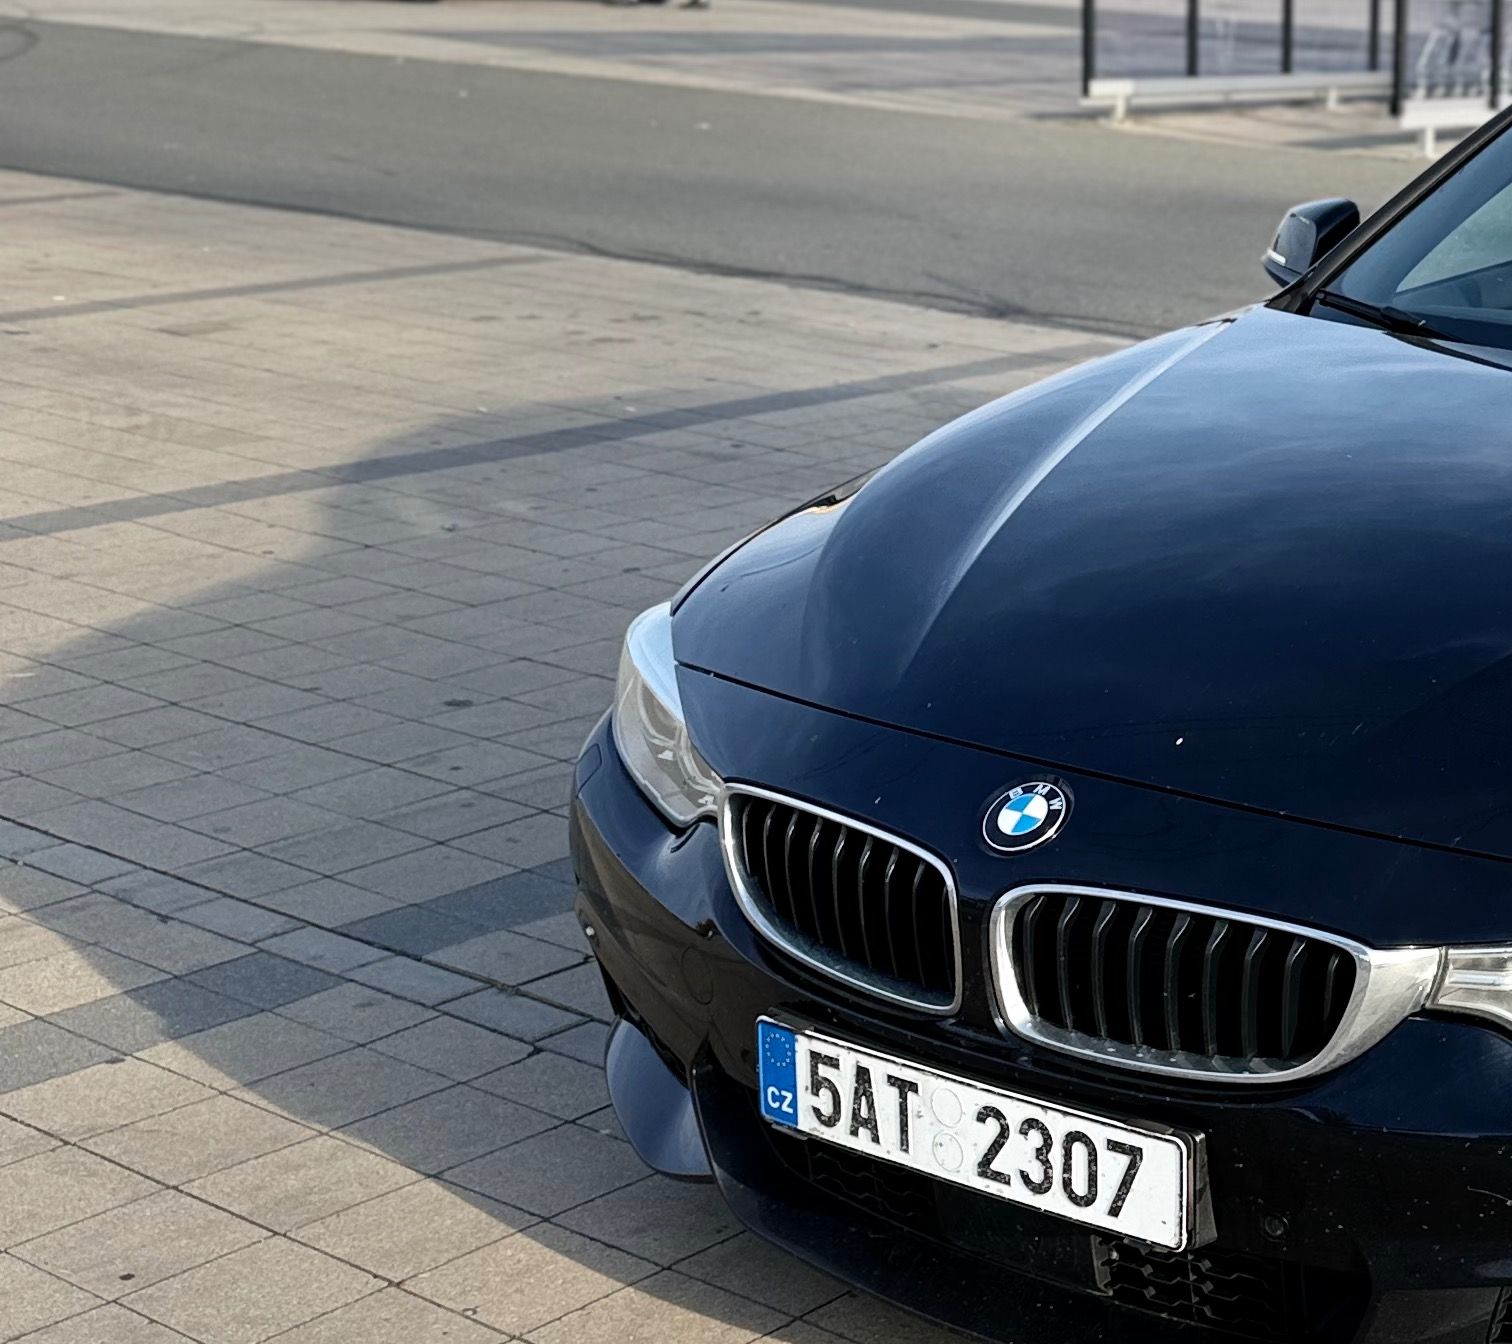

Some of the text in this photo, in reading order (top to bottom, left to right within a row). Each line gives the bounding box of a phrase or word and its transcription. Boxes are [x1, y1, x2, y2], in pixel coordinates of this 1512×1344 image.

[1008, 783, 1063, 810] BMW
[766, 1085, 794, 1114] CZ
[807, 1048, 1144, 1218] 5AT 2307
